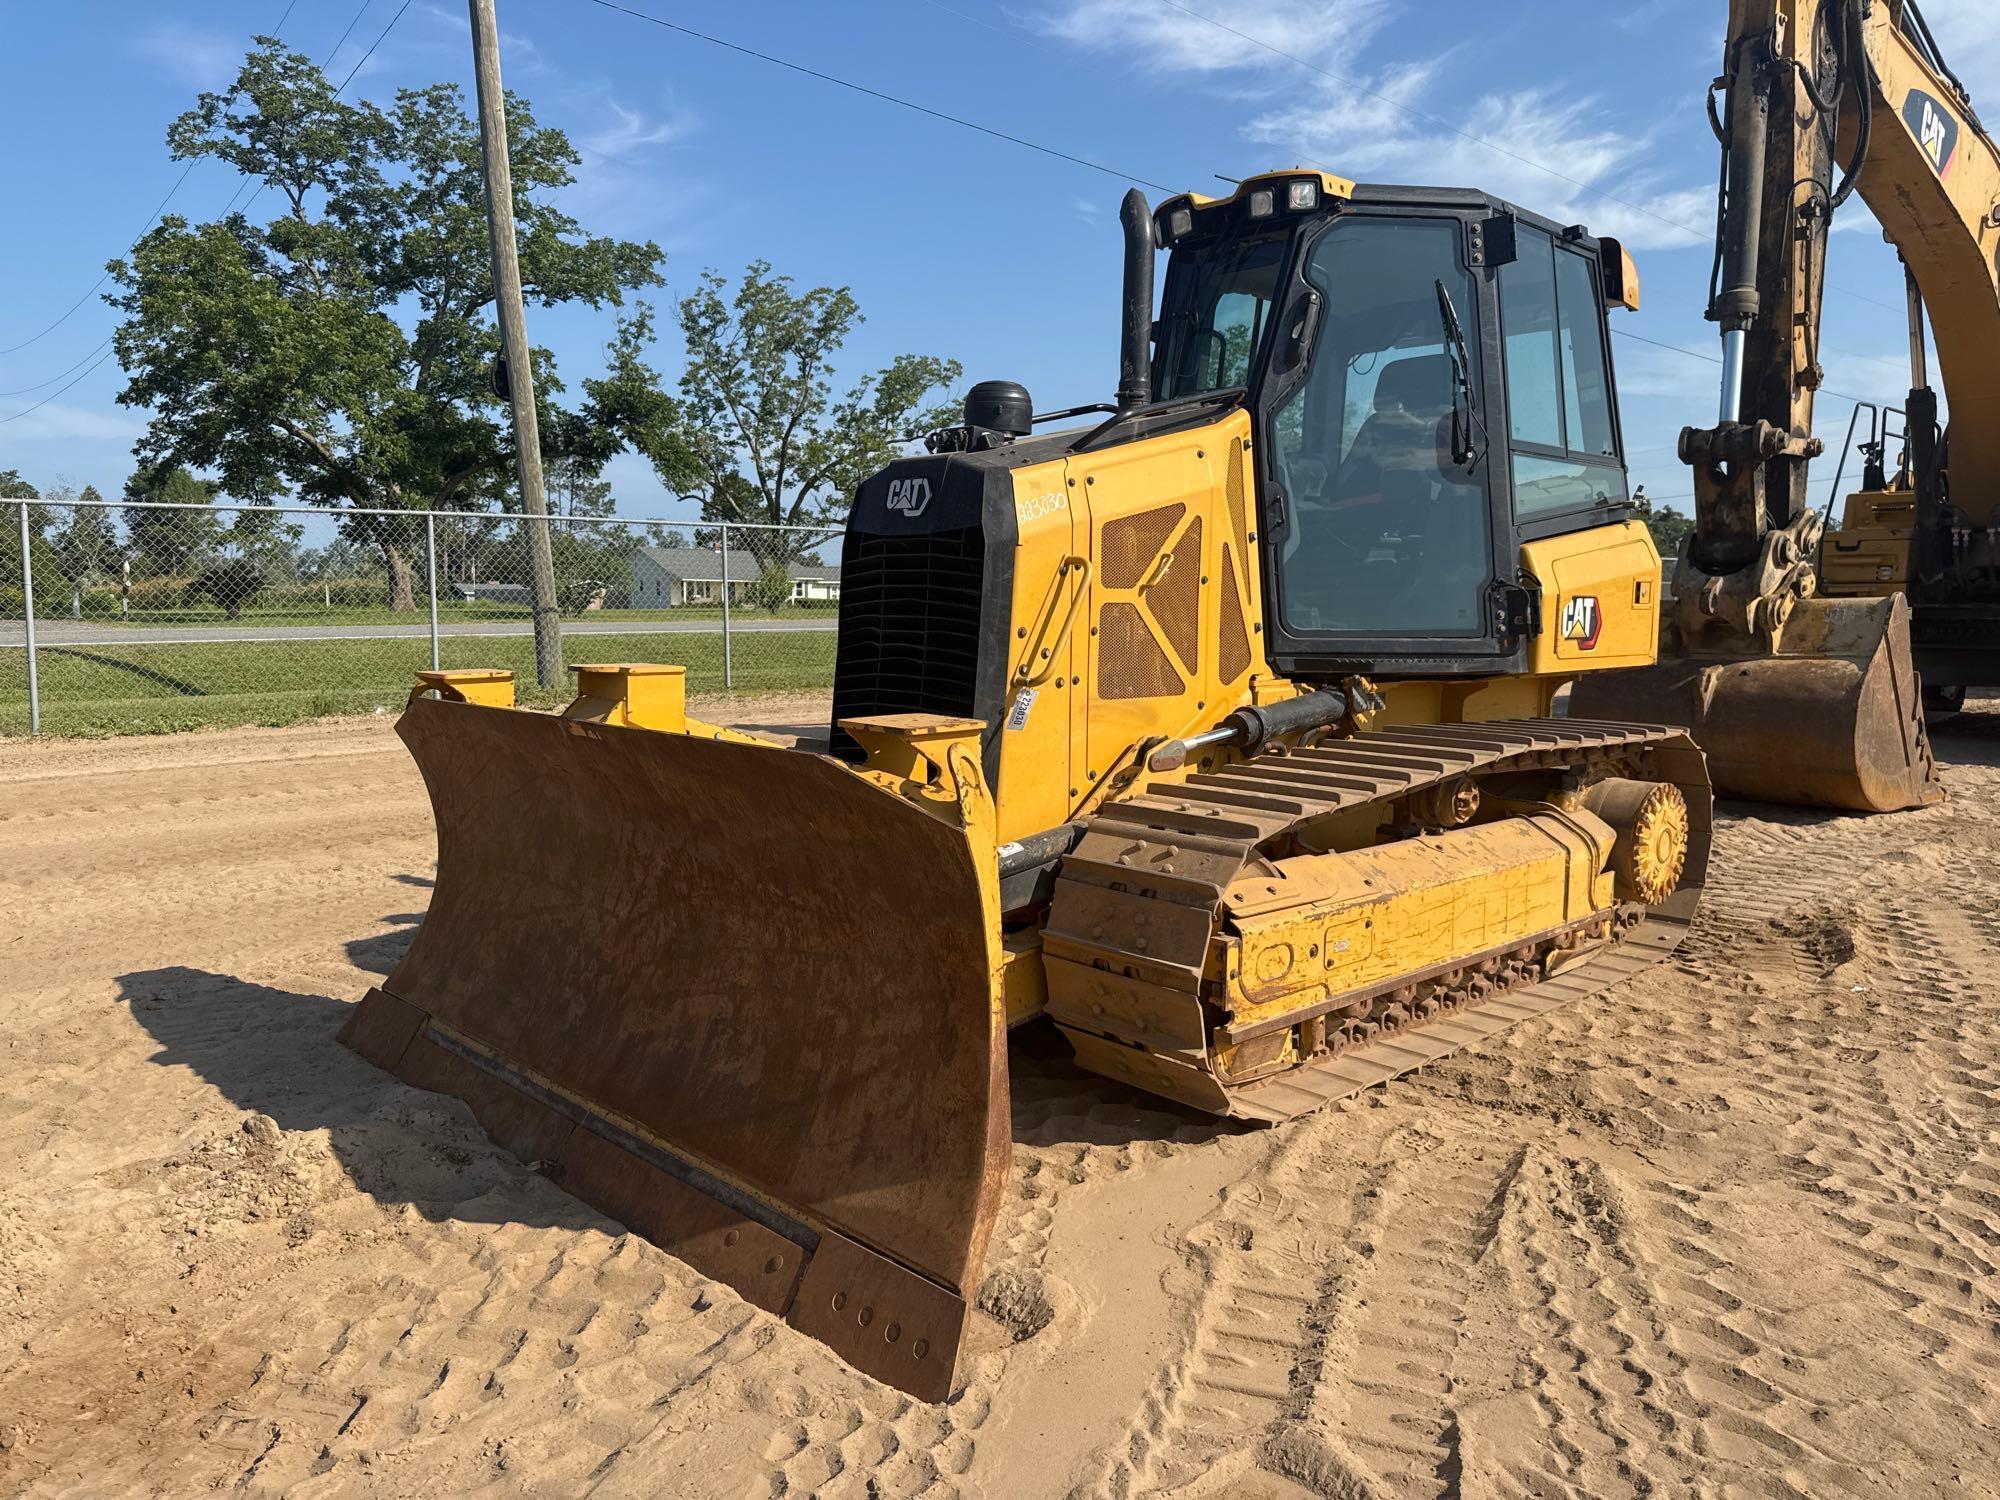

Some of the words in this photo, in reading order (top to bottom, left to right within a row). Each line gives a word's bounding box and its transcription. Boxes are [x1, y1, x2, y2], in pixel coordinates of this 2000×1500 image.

[1921, 100, 1946, 168] CAT
[887, 478, 924, 510] CAT
[1018, 492, 1067, 525] 223030
[1562, 597, 1594, 638] CAT
[1013, 697, 1032, 725] 223030
